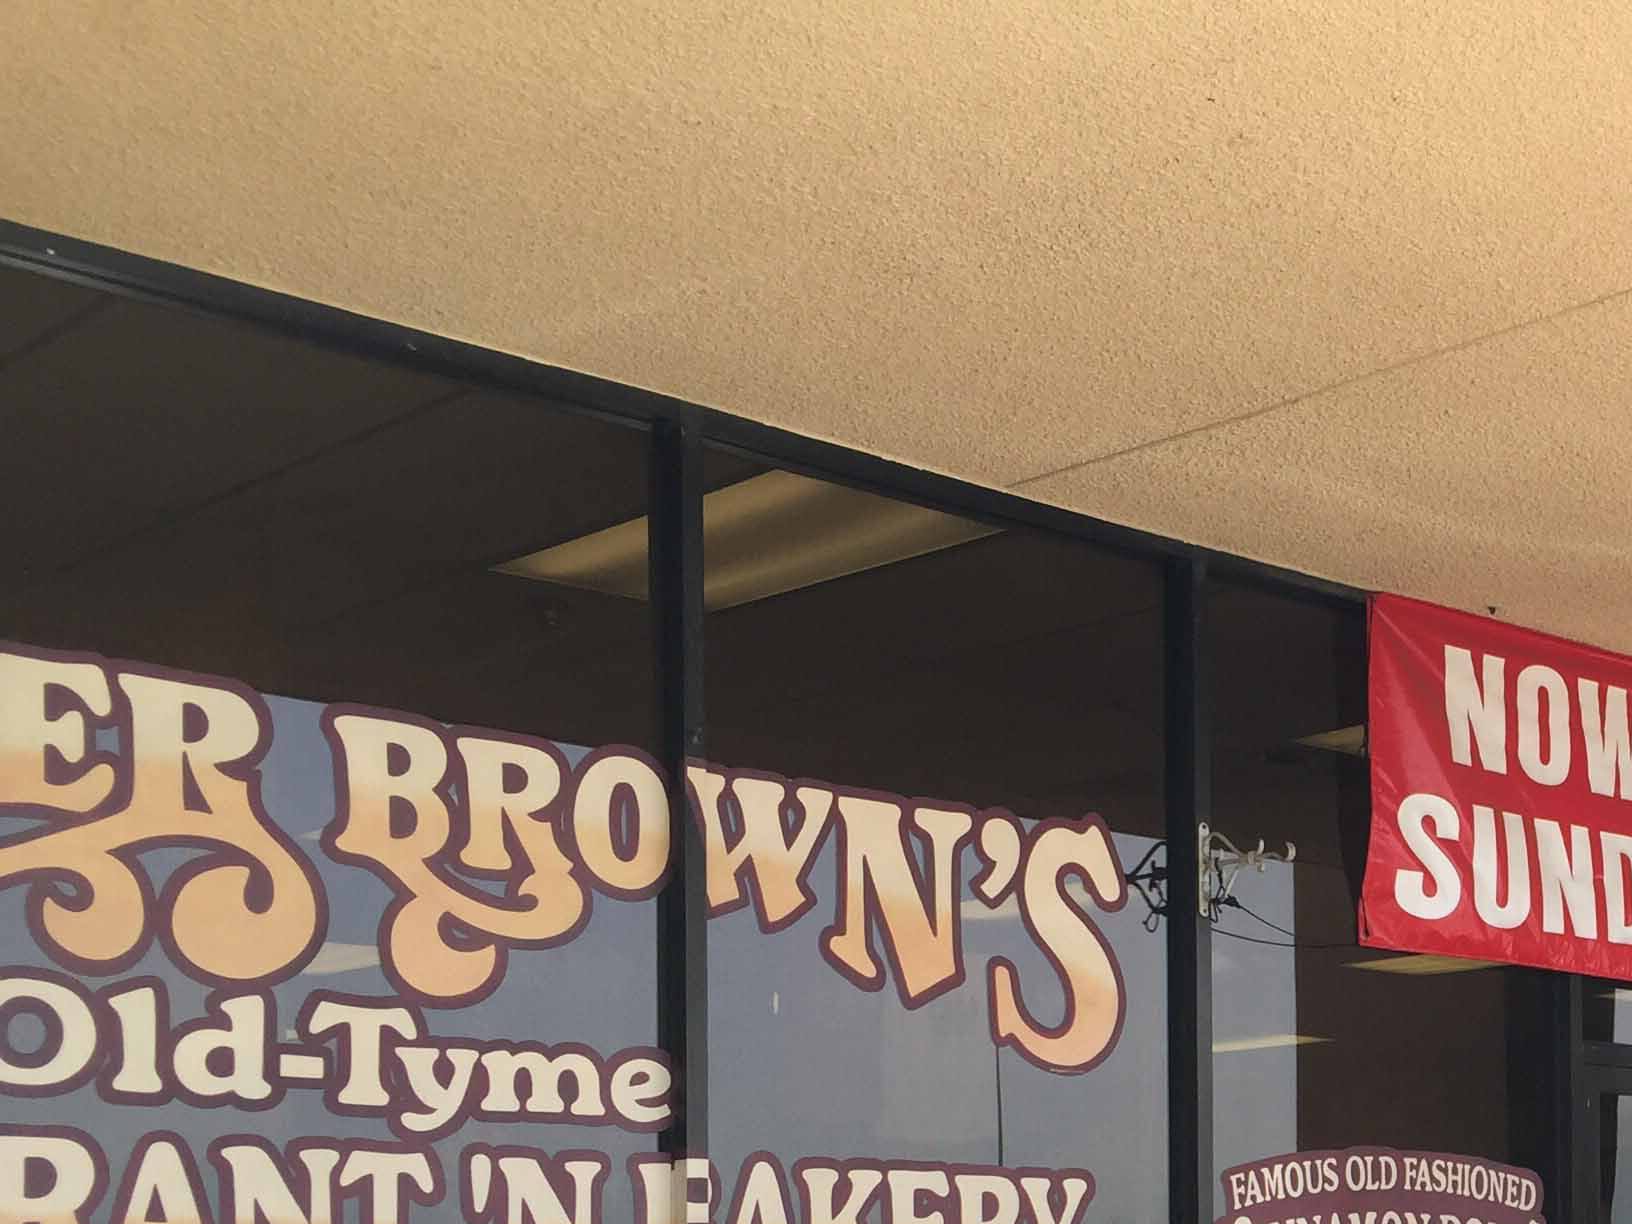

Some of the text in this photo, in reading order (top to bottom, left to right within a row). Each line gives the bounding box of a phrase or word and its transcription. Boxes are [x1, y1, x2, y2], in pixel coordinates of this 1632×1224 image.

[330, 712, 1122, 1068] BROWN'S
[0, 977, 672, 1133] Old-Tyme
[1229, 1154, 1538, 1212] FAMOUS OLD FASHIONED
